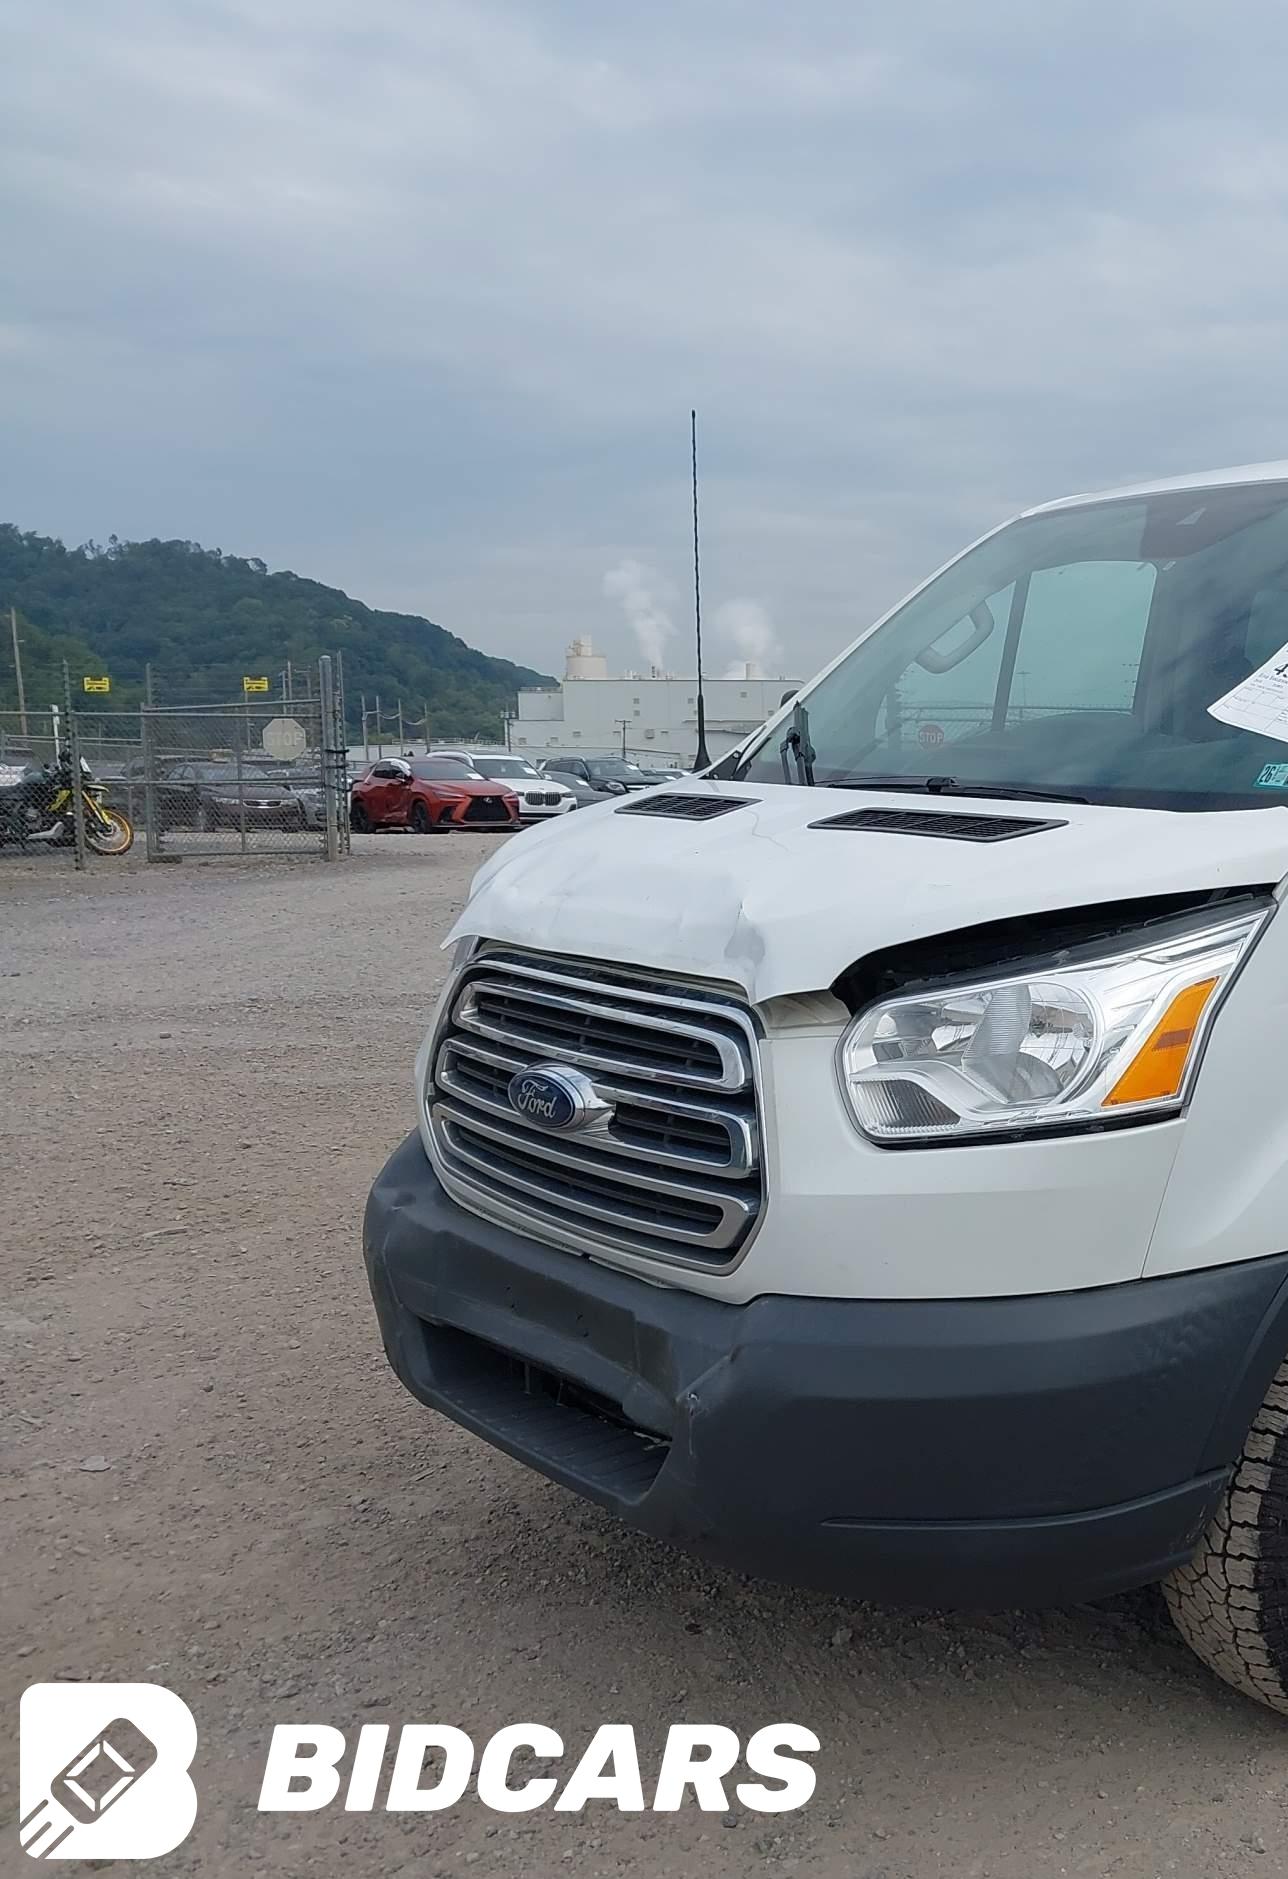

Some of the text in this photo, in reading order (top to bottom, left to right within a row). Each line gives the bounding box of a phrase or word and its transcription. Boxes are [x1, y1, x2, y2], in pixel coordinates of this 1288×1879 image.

[266, 731, 304, 746] STOP
[920, 732, 943, 743] STOP
[1259, 765, 1277, 783] 26
[517, 1079, 557, 1119] Ford
